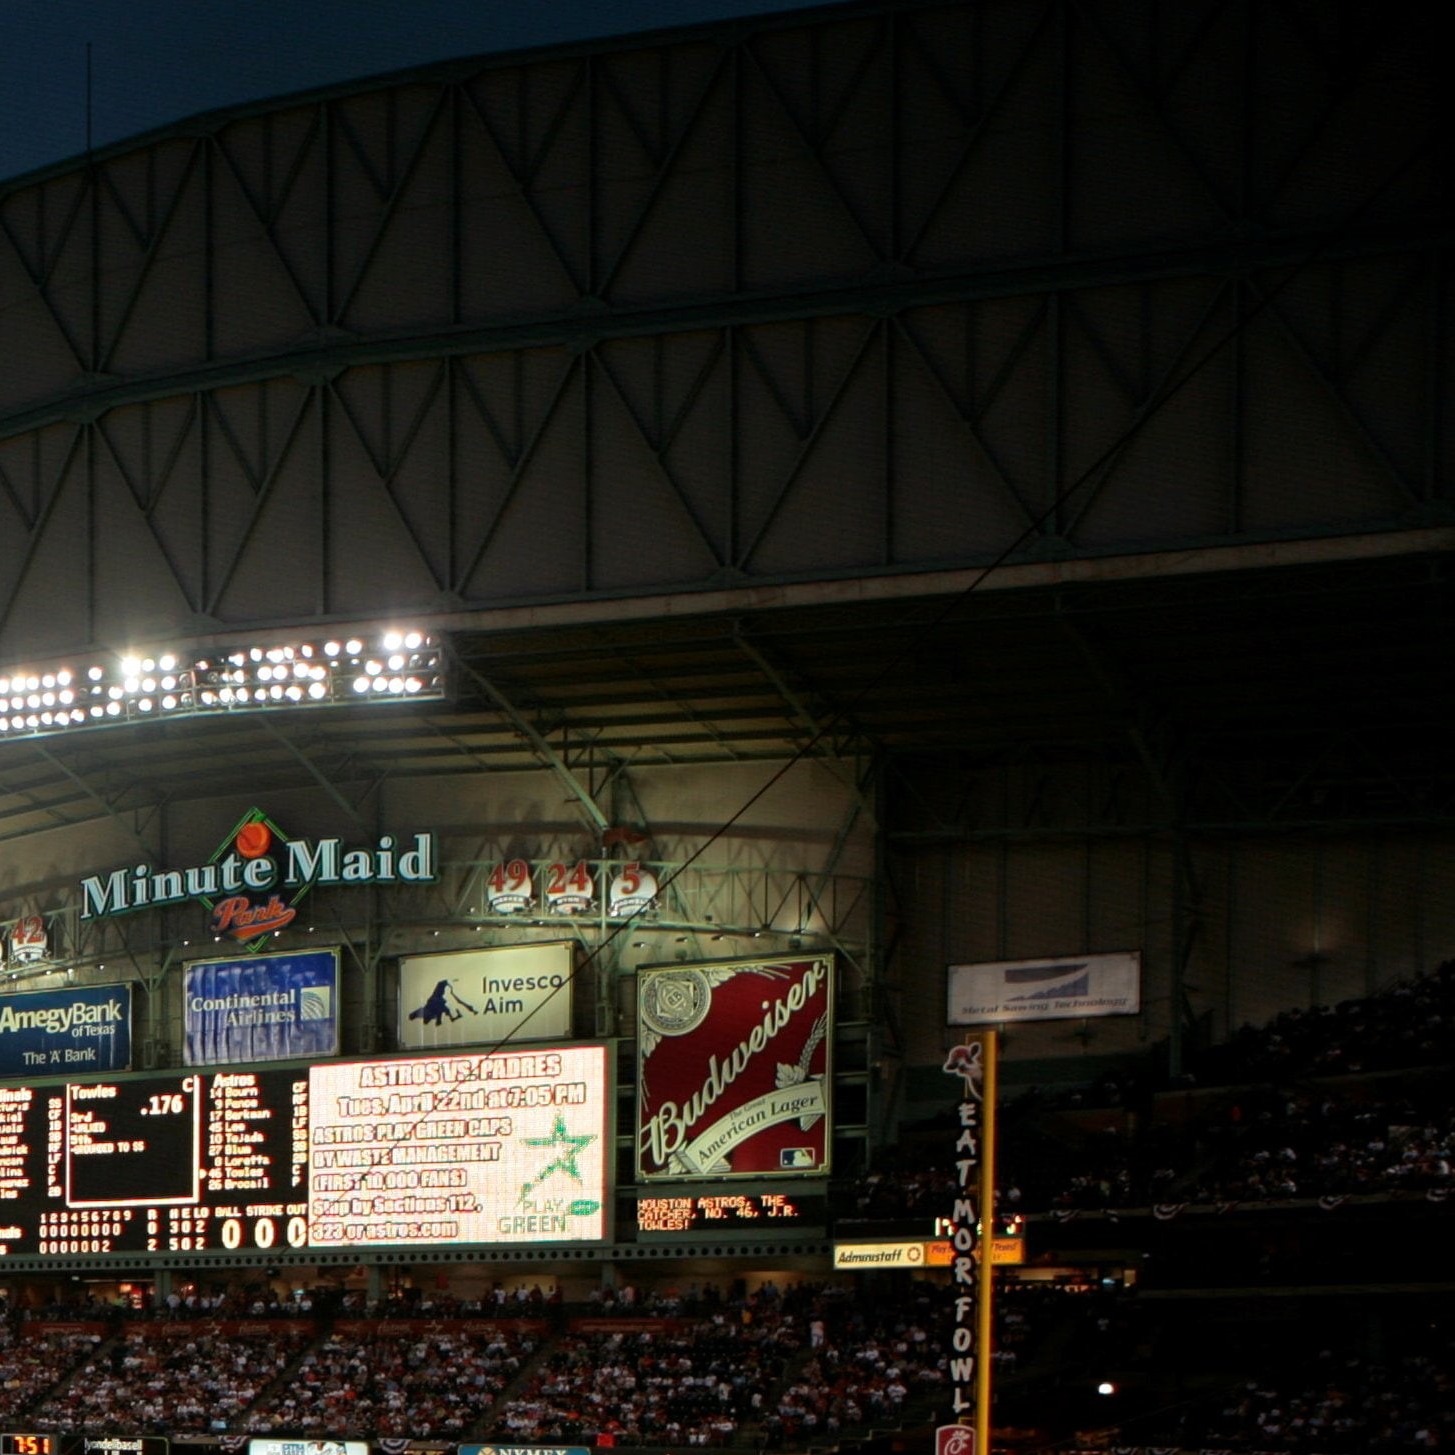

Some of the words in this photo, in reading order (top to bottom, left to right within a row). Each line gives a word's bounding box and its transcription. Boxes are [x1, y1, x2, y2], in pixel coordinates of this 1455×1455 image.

[80, 853, 274, 920] Minute
[285, 833, 435, 883] Maid
[488, 859, 529, 893] 49
[546, 859, 589, 894] 24
[621, 862, 642, 895] 5
[211, 895, 295, 935] Park
[10, 916, 45, 945] 42
[482, 973, 564, 995] Invesco
[190, 988, 297, 1013] Continental
[483, 997, 524, 1015] Aim
[225, 1007, 297, 1027] Airlines
[71, 1025, 84, 1038] of
[84, 1023, 116, 1037] Texas
[22, 1050, 46, 1065] The
[65, 1047, 96, 1063] Bank
[640, 961, 826, 1166] Budweiser
[213, 1072, 255, 1088] Astros
[359, 1062, 441, 1088] ASTROS
[478, 1054, 562, 1080] PADRES
[71, 1085, 116, 1099] Towles
[182, 1078, 194, 1093] C
[389, 1091, 434, 1115] April
[436, 1090, 487, 1112] 22nd
[488, 1089, 508, 1109] at
[509, 1085, 553, 1107] 7:05
[554, 1082, 587, 1105] PM
[140, 1095, 183, 1115] .176
[313, 1125, 375, 1145] ASTROS
[376, 1122, 413, 1142] PLAY
[415, 1119, 466, 1140] GREEN
[468, 1117, 512, 1137] CAPS
[697, 1106, 767, 1164] American
[770, 1094, 818, 1117] Lager
[313, 1150, 335, 1169] BY
[336, 1147, 391, 1168] WASTE
[391, 1142, 502, 1165] MANAGEMENT
[420, 1168, 467, 1188] FANS)
[215, 1206, 242, 1217] BALL
[246, 1205, 284, 1217] STRIKE
[286, 1203, 308, 1215] OUT
[637, 1197, 691, 1209] HOUSTON
[761, 1195, 786, 1207] THE
[768, 1205, 799, 1217] J.R.
[497, 1215, 568, 1235] GREEN
[637, 1219, 689, 1231] TOWLES!
[837, 1248, 903, 1264] Administaff
[14, 1436, 50, 1455] 7:51
